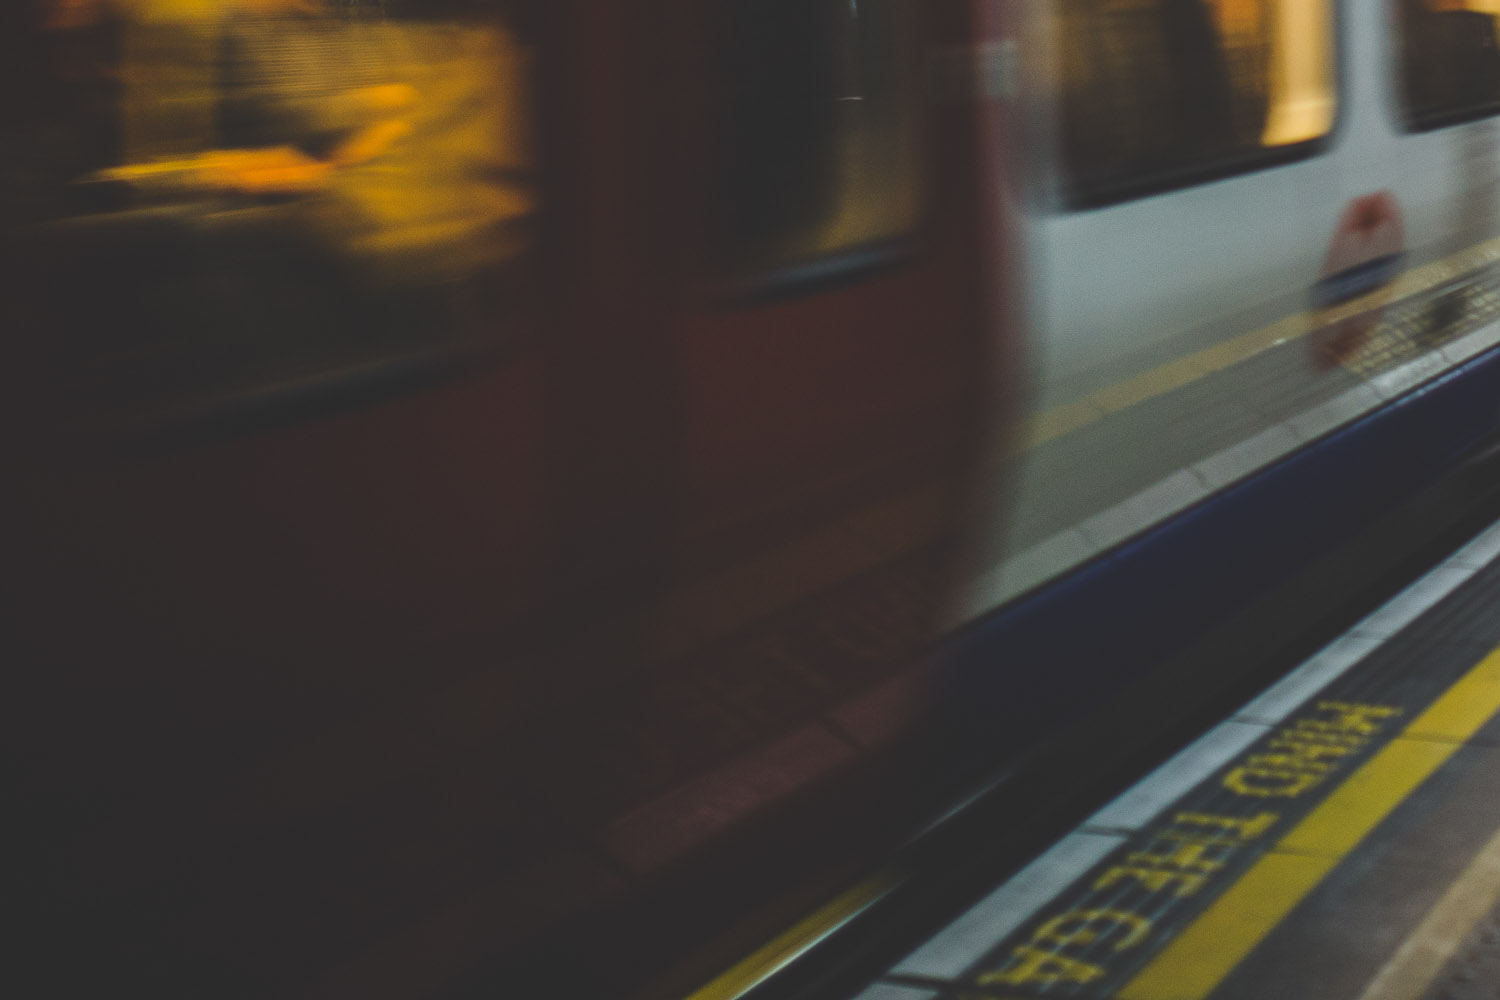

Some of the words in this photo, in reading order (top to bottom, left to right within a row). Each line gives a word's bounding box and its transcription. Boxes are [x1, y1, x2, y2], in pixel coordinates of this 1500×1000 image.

[1224, 701, 1402, 797] MIND
[1093, 811, 1280, 896] THE
[975, 909, 1152, 992] GA
